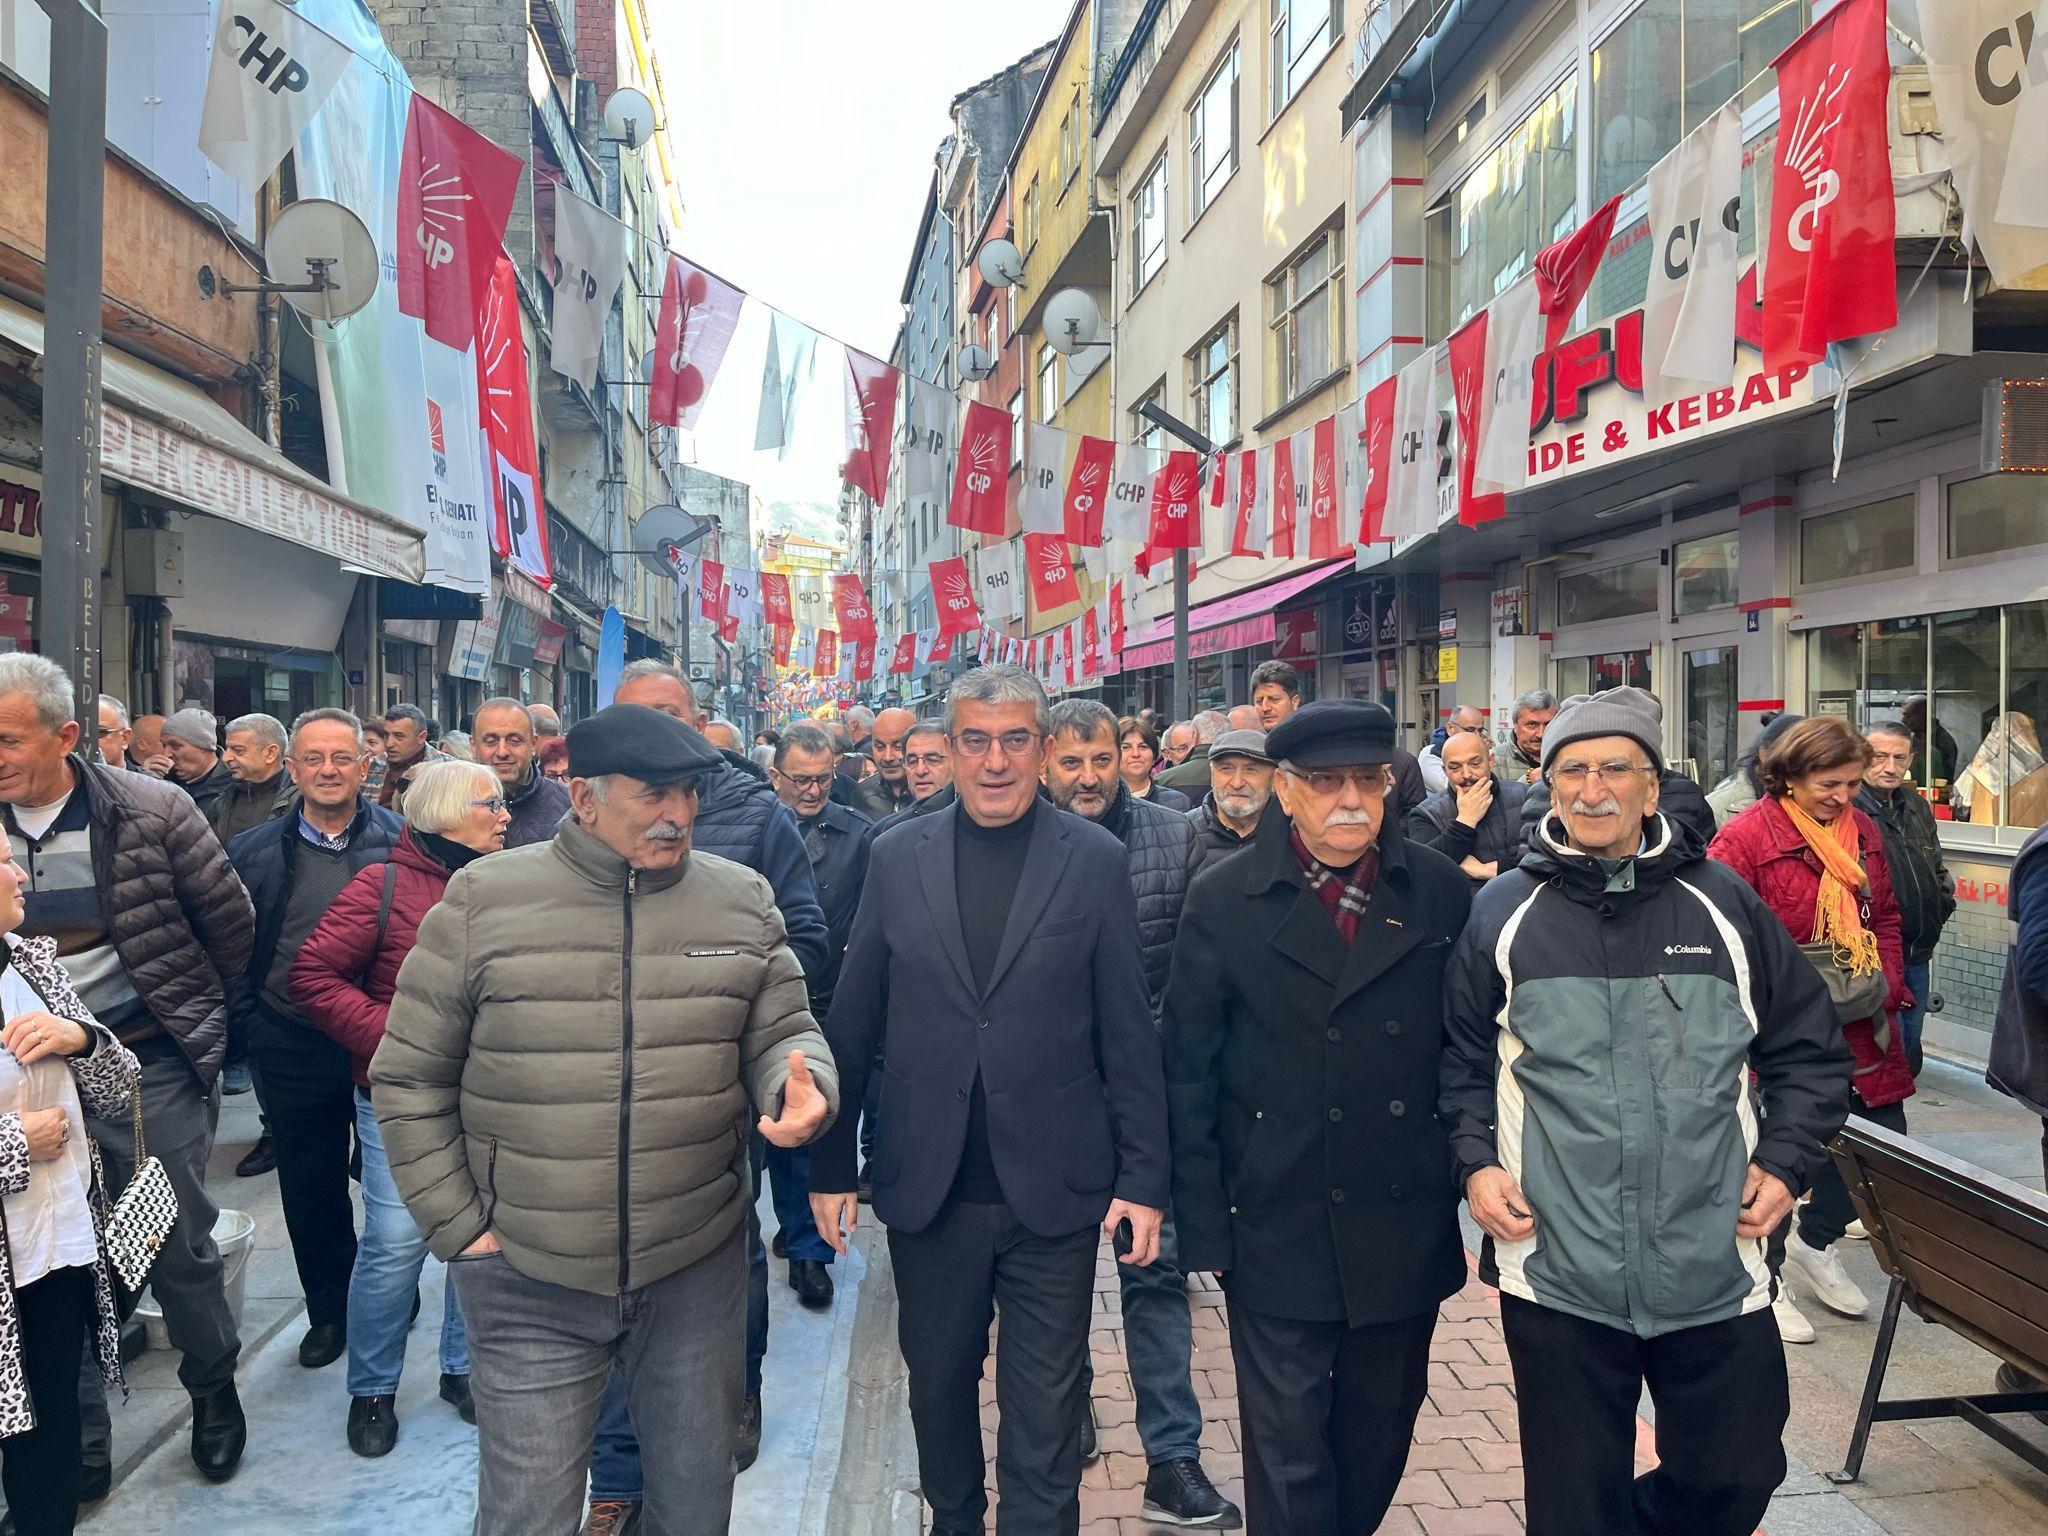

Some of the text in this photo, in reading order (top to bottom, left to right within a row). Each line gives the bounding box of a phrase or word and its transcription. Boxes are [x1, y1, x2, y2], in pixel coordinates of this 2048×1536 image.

[221, 15, 309, 94] CHP
[1788, 169, 1840, 252] CP
[1603, 420, 1628, 453] &
[1647, 361, 1810, 440] KEBAP
[966, 472, 990, 495] CHP
[1115, 482, 1145, 503] CHP
[1074, 494, 1092, 513] CP
[1167, 503, 1187, 519] CHP
[1674, 944, 1712, 955] Columbia
